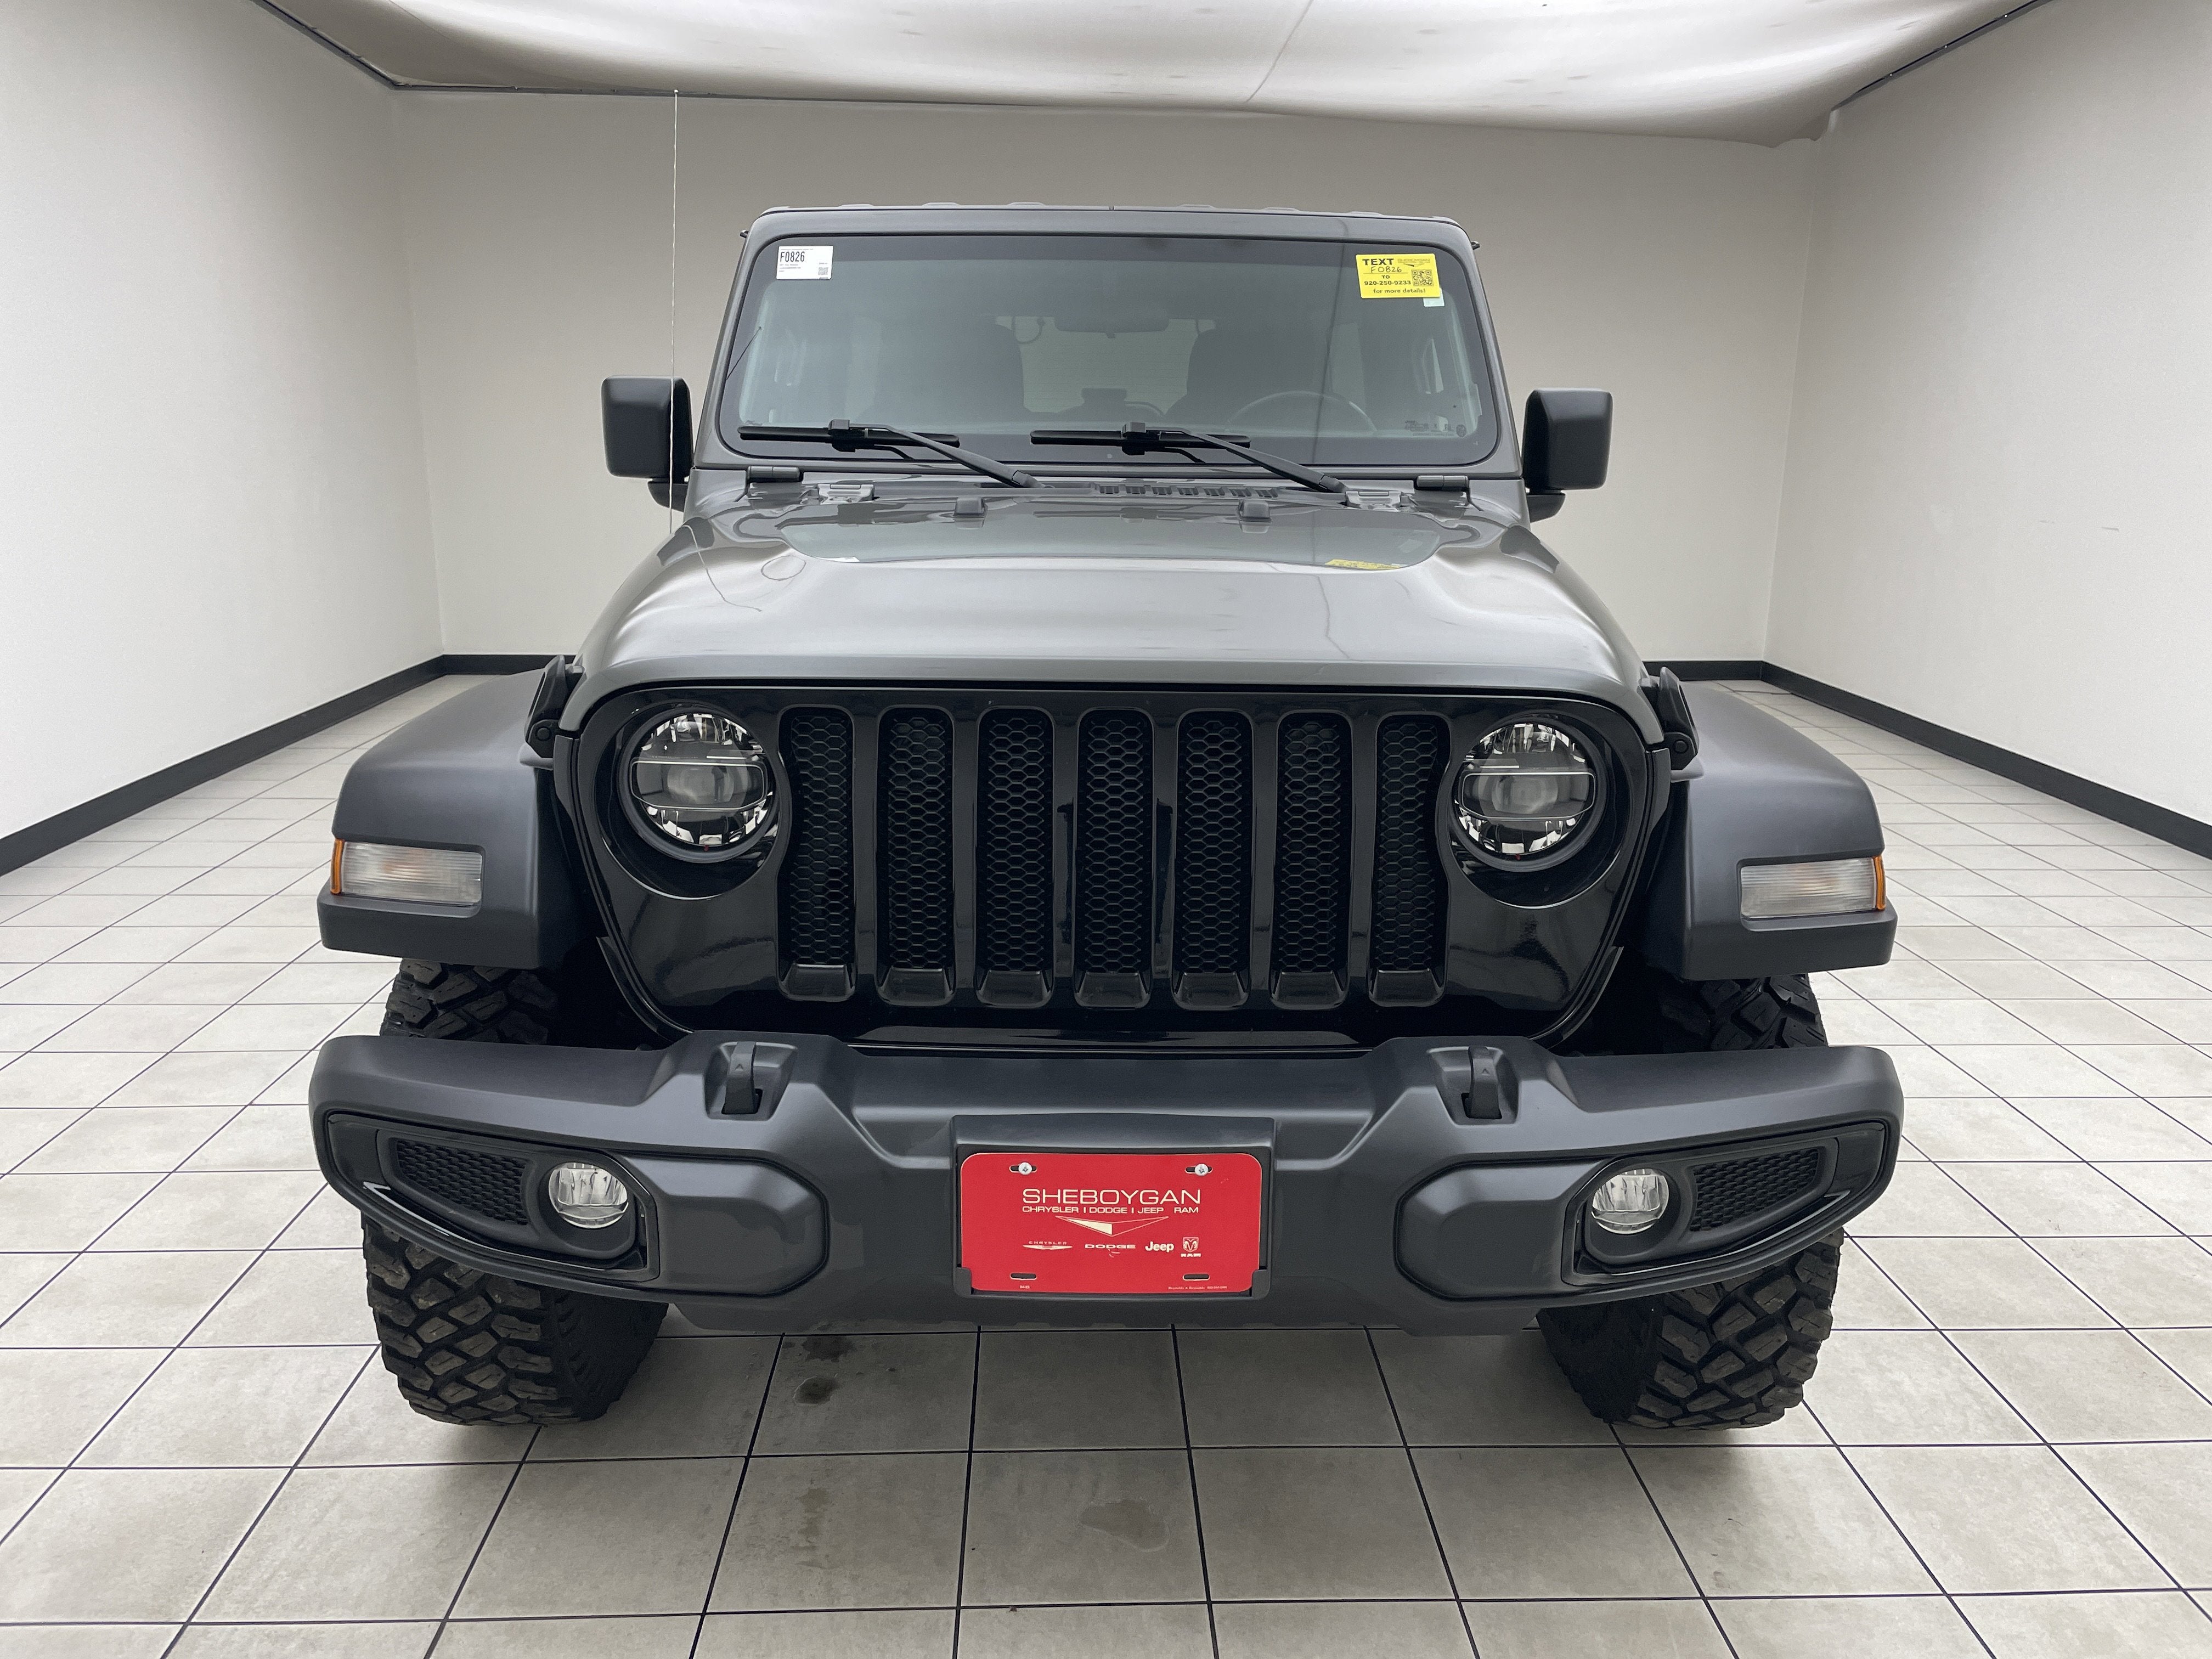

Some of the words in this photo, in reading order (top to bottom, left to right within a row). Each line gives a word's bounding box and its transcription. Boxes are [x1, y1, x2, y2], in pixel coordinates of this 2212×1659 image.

[780, 251, 805, 262] F0826
[1023, 1188, 1201, 1205] SHEBOYGAN
[1145, 1241, 1175, 1253] Jeep
